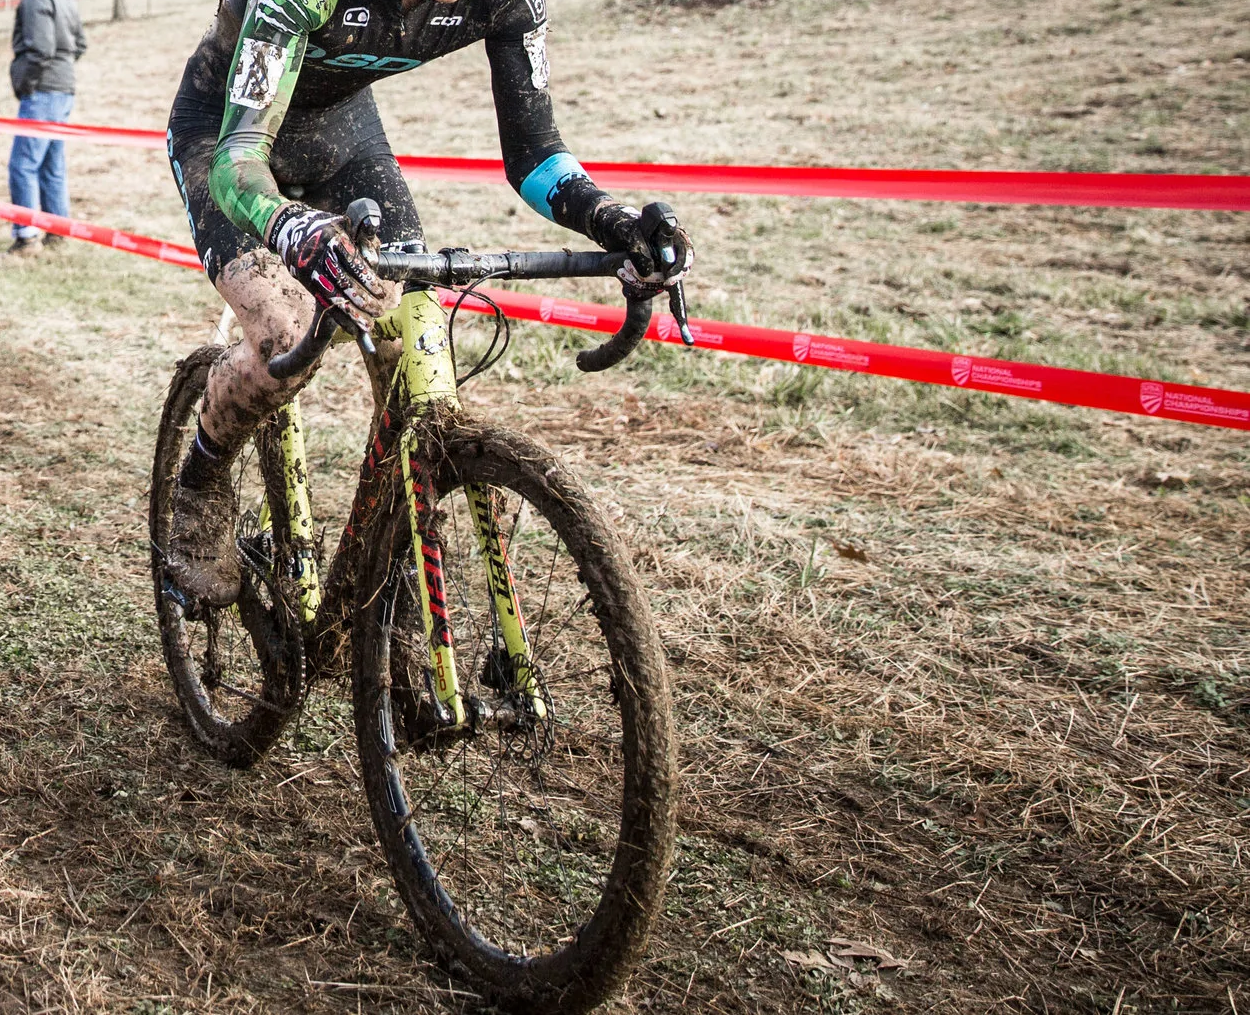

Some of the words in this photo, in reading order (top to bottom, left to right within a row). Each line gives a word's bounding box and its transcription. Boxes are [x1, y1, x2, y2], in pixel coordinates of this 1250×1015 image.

[1164, 391, 1214, 406] NATIONAL
[1163, 399, 1249, 418] CHAMPIONSHIPS
[435, 651, 447, 692] RDO
